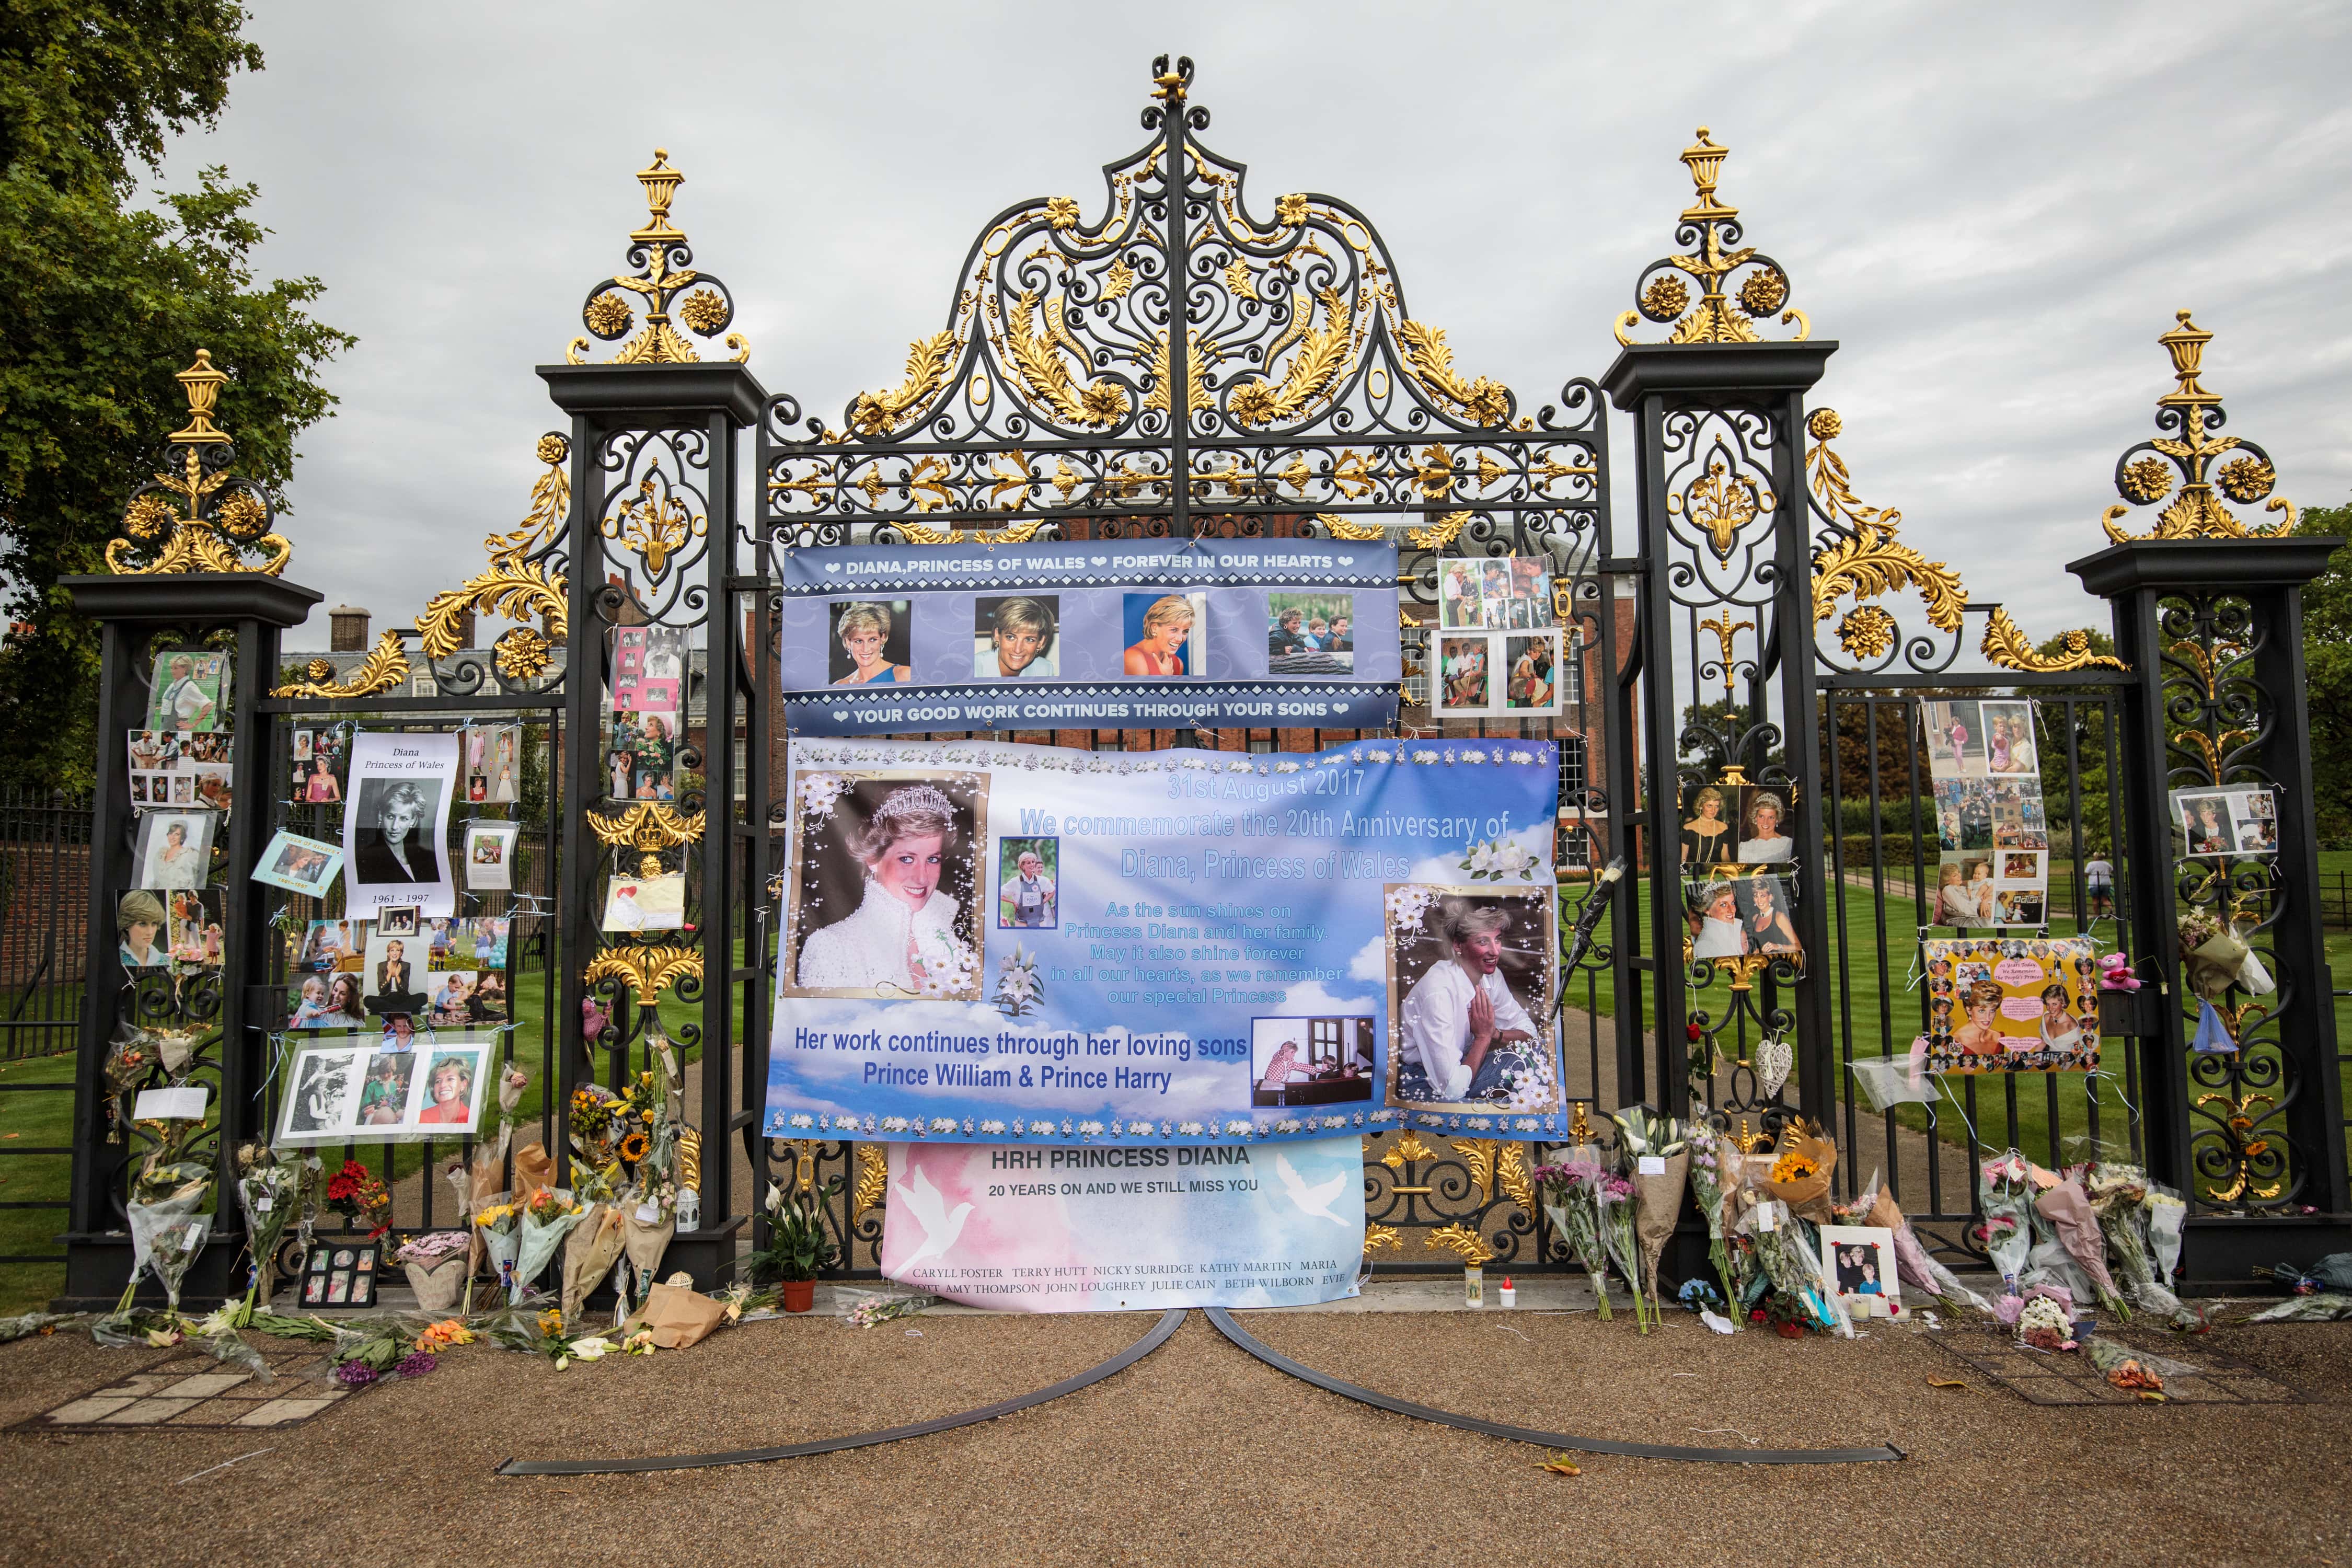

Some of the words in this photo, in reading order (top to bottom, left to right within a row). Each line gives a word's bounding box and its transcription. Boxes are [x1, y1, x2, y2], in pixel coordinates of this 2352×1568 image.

[998, 558, 1021, 570] OF
[1026, 557, 1086, 570] WALES
[1113, 555, 1193, 568] FOREVER
[1197, 555, 1215, 568] IN
[1220, 555, 1259, 567] OUR
[1264, 555, 1332, 568] HEARTS
[853, 709, 903, 723] YOUR
[910, 707, 960, 721] GOOD
[964, 705, 1020, 719] WORK
[1024, 703, 1128, 718] CONTINUES
[1133, 703, 1219, 717] THROUGH
[1223, 703, 1274, 716] YOUR
[1278, 702, 1327, 716] SONS
[365, 760, 403, 769] Princess
[405, 760, 417, 769] of
[1168, 774, 1217, 799] 31st
[1223, 774, 1308, 802] August
[1315, 769, 1365, 795] 2017
[1020, 808, 1056, 835] We
[1064, 810, 1235, 836] commemorate
[1242, 808, 1278, 836] the
[1286, 808, 1333, 836] 20th
[1341, 810, 1478, 845] Anniversary
[1485, 810, 1510, 838] of
[1122, 849, 1196, 883] Diana,
[1204, 849, 1306, 879] Princess
[1313, 850, 1336, 879] of
[1342, 850, 1410, 879] Wales
[372, 895, 395, 903] 1961
[406, 894, 429, 903] 1997
[1105, 902, 1129, 917] As
[1135, 902, 1162, 917] the
[1168, 905, 1201, 918] sun
[1206, 903, 1264, 918] shines
[1270, 906, 1292, 918] on
[1065, 923, 1143, 939] Princess
[1148, 924, 1198, 939] Diana
[1204, 924, 1236, 939] and
[1242, 924, 1271, 939] her
[1275, 924, 1329, 942] family.
[1090, 944, 1126, 964] May
[1132, 945, 1143, 960] it
[1148, 945, 1186, 960] also
[1191, 945, 1239, 960] shine
[1244, 946, 1305, 960] forever
[1051, 966, 1067, 981] in
[1072, 966, 1093, 981] all
[1099, 969, 1129, 982] our
[1134, 966, 1195, 984] hearts,
[1202, 970, 1221, 982] as
[1226, 970, 1251, 982] we
[1256, 966, 1343, 982] remember
[1108, 991, 1139, 1004] our
[1143, 988, 1206, 1007] special
[1212, 988, 1287, 1004] Princess
[795, 1027, 828, 1050] Her
[833, 1029, 882, 1051] work
[888, 1030, 989, 1054] continues
[996, 1032, 1078, 1060] through
[1087, 1033, 1121, 1055] her
[1127, 1033, 1191, 1062] loving
[1197, 1038, 1247, 1056] sons
[864, 1062, 929, 1086] Prince
[935, 1063, 1011, 1087] William
[1019, 1065, 1033, 1088] &
[1041, 1065, 1108, 1089] Prince
[1115, 1066, 1172, 1094] Harry
[992, 1150, 1042, 1169] HRH
[1050, 1148, 1169, 1168] PRINCESS
[1178, 1146, 1250, 1166] DIANA
[989, 1185, 1005, 1196] 20
[1009, 1184, 1056, 1196] YEARS
[1060, 1183, 1082, 1195] ON
[1086, 1183, 1116, 1195] AND
[1120, 1182, 1143, 1194] WE
[1146, 1181, 1185, 1193] STILL
[1189, 1180, 1225, 1192] MISS
[1228, 1179, 1259, 1192] YOU
[913, 1269, 958, 1278] CARYLL
[960, 1269, 1004, 1278] FOSTER
[1012, 1267, 1051, 1277] TERRY
[1055, 1266, 1088, 1276] HUTT
[1093, 1265, 1132, 1275] NICKY
[1135, 1264, 1194, 1275] SURRIDGE
[1200, 1263, 1240, 1273] KATHY
[1243, 1261, 1292, 1272] MARTIN
[1300, 1260, 1338, 1270] MARIA
[945, 1284, 971, 1293] AMY
[975, 1284, 1040, 1294] THOMPSON
[1045, 1283, 1078, 1295] JOHN
[1081, 1281, 1146, 1292] LOUGHREY
[1150, 1281, 1183, 1292] JULIE
[1185, 1279, 1216, 1289] CAIN
[1225, 1279, 1255, 1288] BETH
[1259, 1276, 1315, 1288] WILBORN
[1323, 1273, 1345, 1284] EVIE
